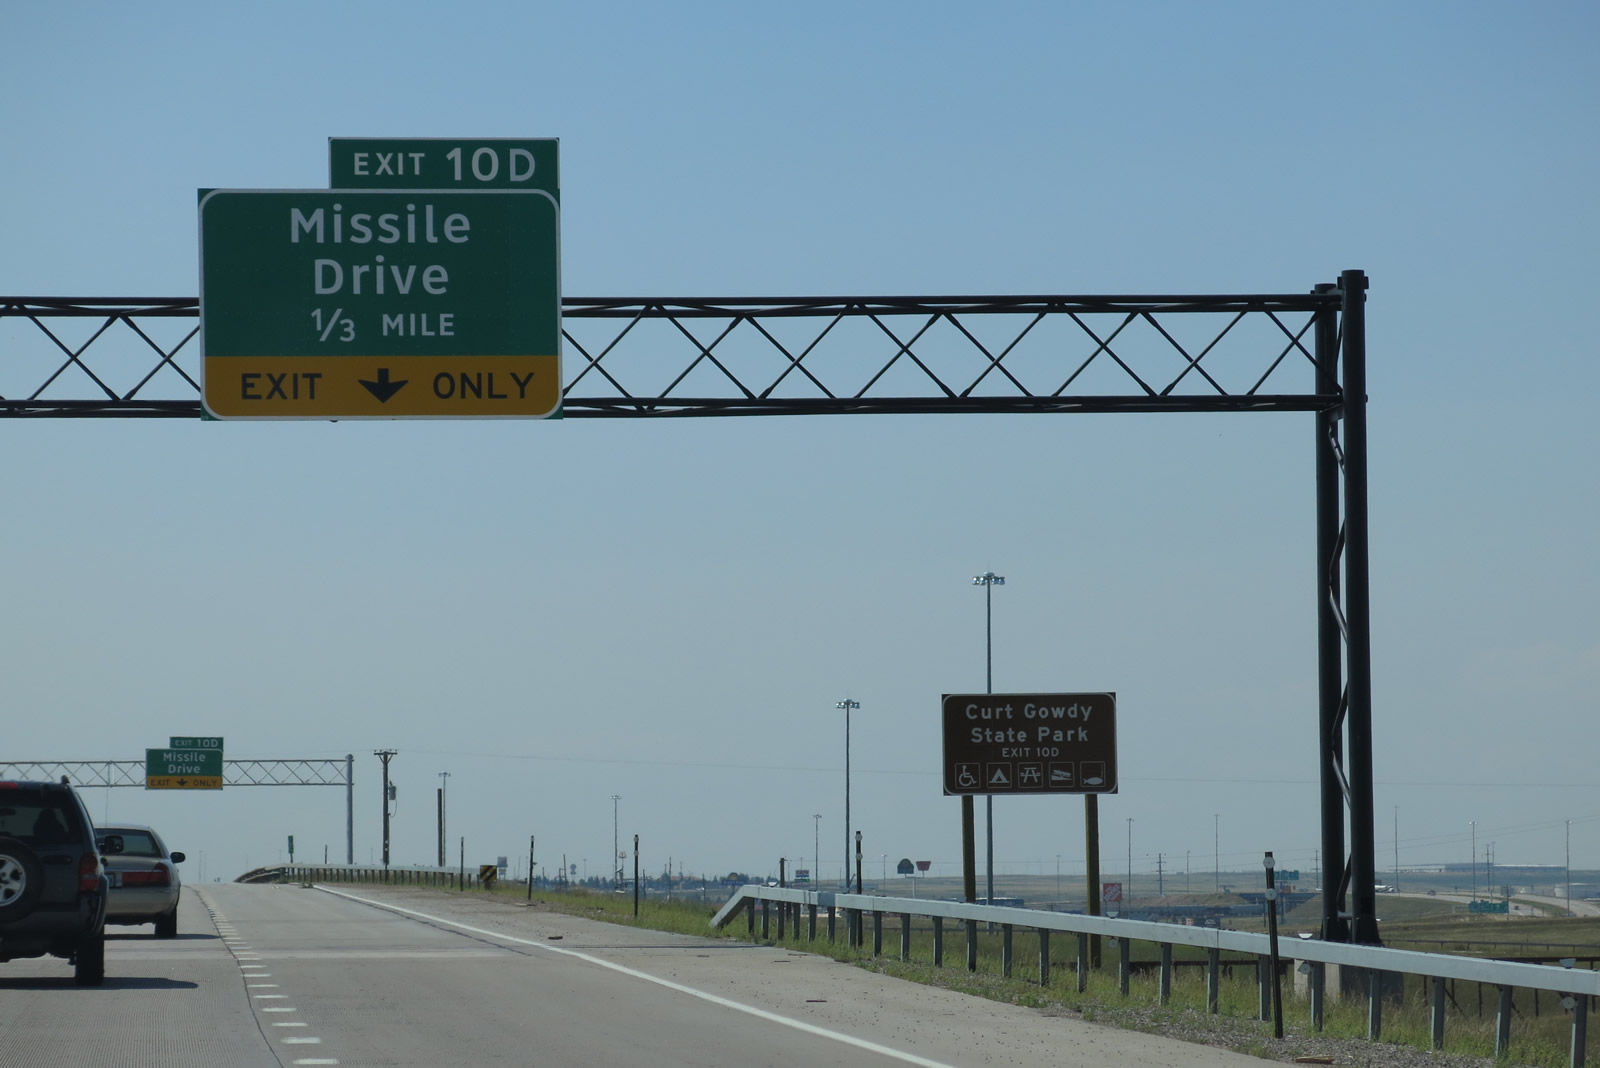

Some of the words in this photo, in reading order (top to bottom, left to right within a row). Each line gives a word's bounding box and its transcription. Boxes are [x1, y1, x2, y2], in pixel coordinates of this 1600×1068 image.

[355, 152, 425, 176] EXIT
[446, 147, 536, 182] 10D
[290, 203, 471, 244] Missile
[314, 254, 449, 295] Drive
[382, 313, 455, 337] MILE
[241, 372, 323, 401] EXIT
[432, 371, 535, 400] ONLY
[965, 703, 1013, 720] Curt
[1024, 703, 1093, 722] Gowdy
[174, 739, 193, 747] EXIT
[197, 738, 219, 748] 10D
[971, 727, 1027, 743] State
[1038, 726, 1089, 742] Park
[163, 751, 206, 762] Missile
[1002, 747, 1031, 758] EXIT
[1036, 747, 1059, 758] 10D
[167, 763, 201, 774] Drive
[150, 779, 171, 787] EXIT
[193, 779, 218, 787] ONLY
